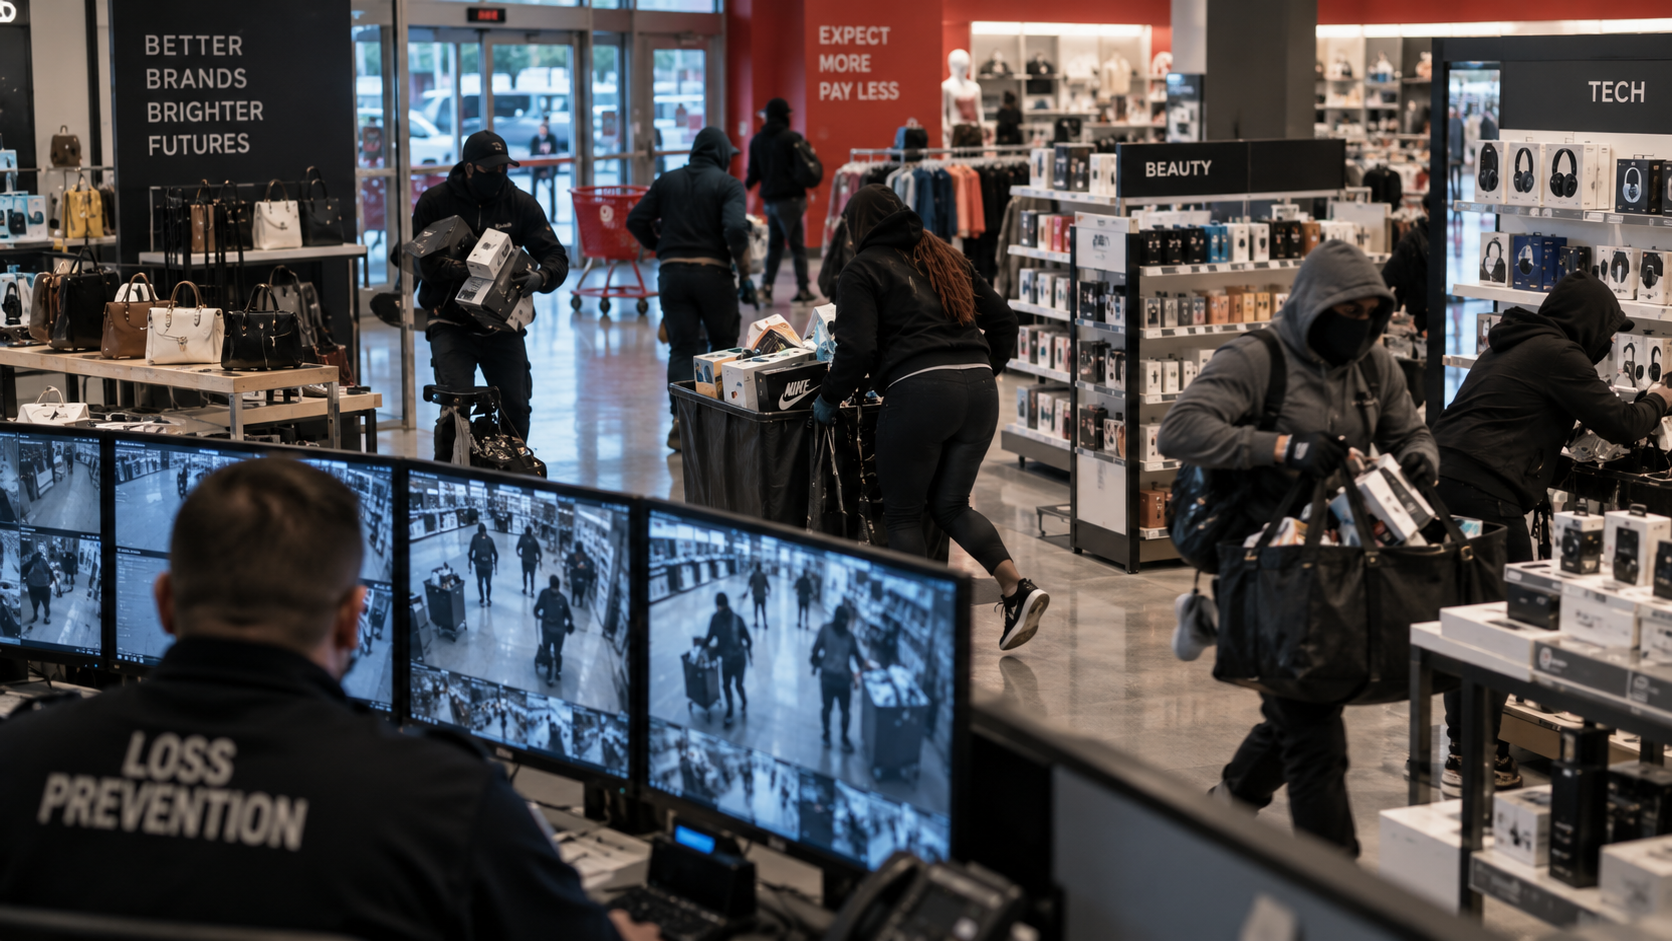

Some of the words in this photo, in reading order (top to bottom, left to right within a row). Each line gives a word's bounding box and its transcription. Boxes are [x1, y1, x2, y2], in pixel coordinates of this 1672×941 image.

[145, 34, 243, 56] BETTER
[819, 25, 891, 46] EXPECT
[819, 53, 871, 73] MORE
[146, 67, 247, 90] BRANDS
[819, 81, 853, 101] PAY
[857, 81, 900, 101] LESS
[1587, 80, 1646, 103] TECH
[147, 100, 264, 123] BRIGHTER
[148, 132, 250, 156] FUTURES
[1145, 159, 1212, 178] BEAUTY
[784, 378, 811, 398] NIKE
[121, 730, 237, 787] LOSS
[38, 772, 309, 850] PREVENTION
